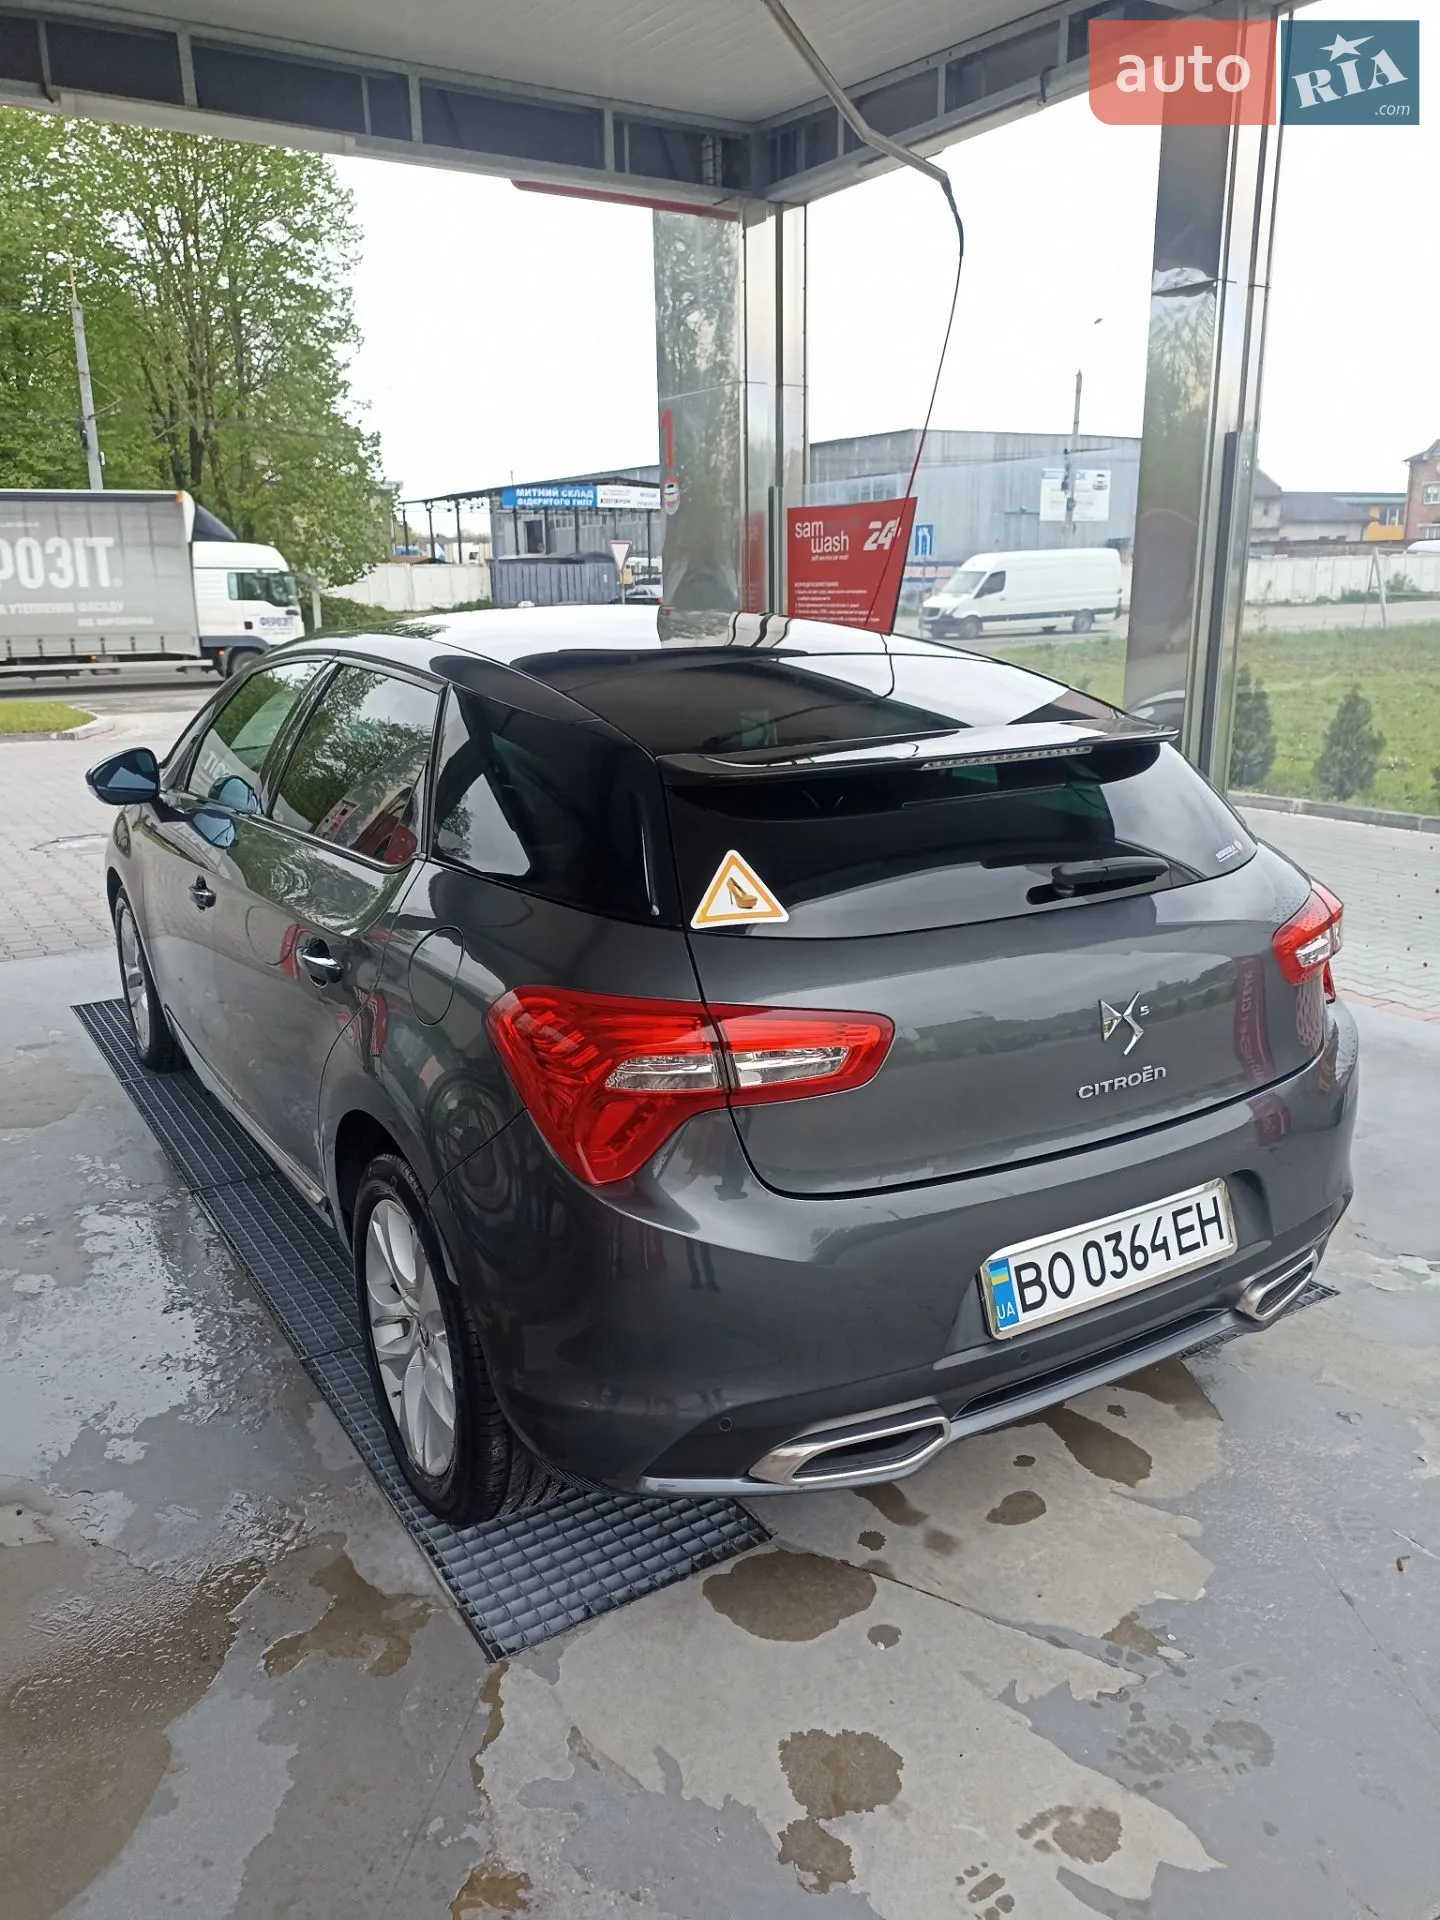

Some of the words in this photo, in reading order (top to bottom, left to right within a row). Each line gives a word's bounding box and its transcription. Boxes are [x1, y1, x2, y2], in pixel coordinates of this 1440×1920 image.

[516, 487, 559, 497] МИТНИЙ
[561, 489, 594, 498] СКЛАД
[795, 520, 824, 538] sam
[811, 530, 849, 554] wash
[996, 1302, 1016, 1320] UA
